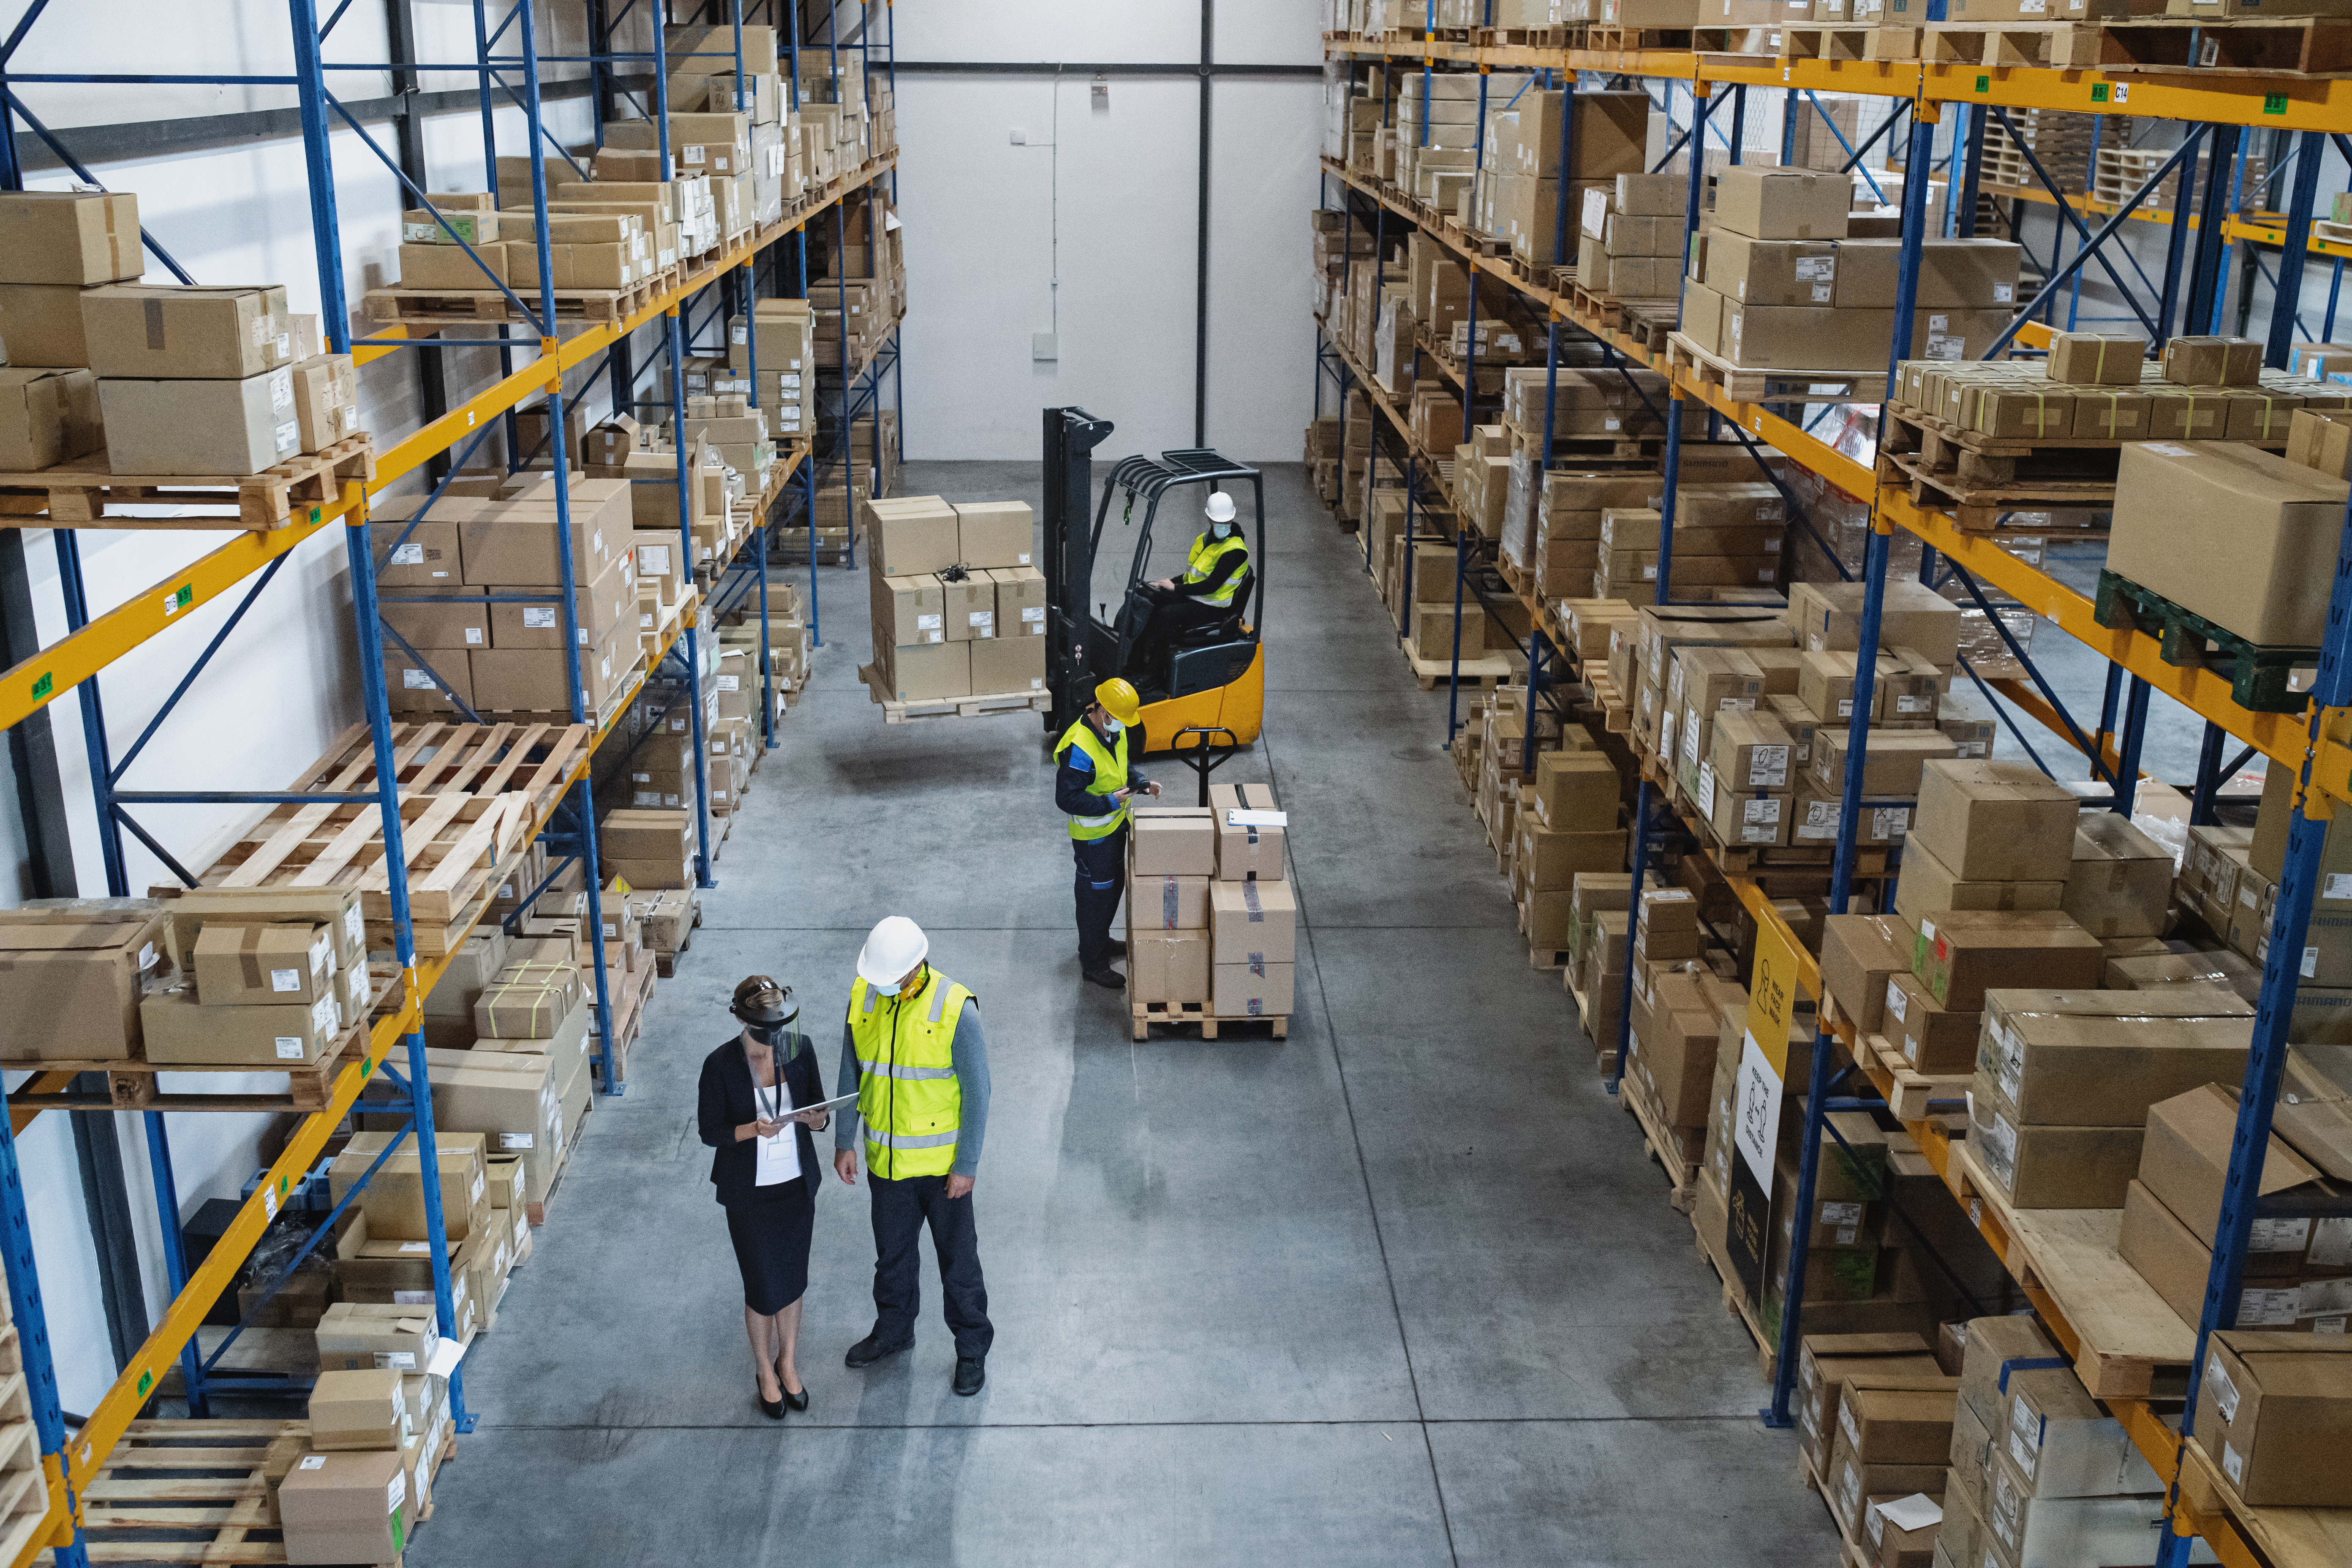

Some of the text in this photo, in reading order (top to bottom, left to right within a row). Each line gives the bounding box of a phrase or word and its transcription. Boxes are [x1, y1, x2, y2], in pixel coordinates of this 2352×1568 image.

[2116, 87, 2127, 98] C14
[1772, 980, 1783, 1002] WEAR
[2297, 997, 2351, 1006] HIMANO
[1770, 993, 1781, 1014] FACE
[1769, 1005, 1780, 1028] MASK
[1752, 1065, 1761, 1083] KEEP
[1746, 1124, 1763, 1158] DISTANCE
